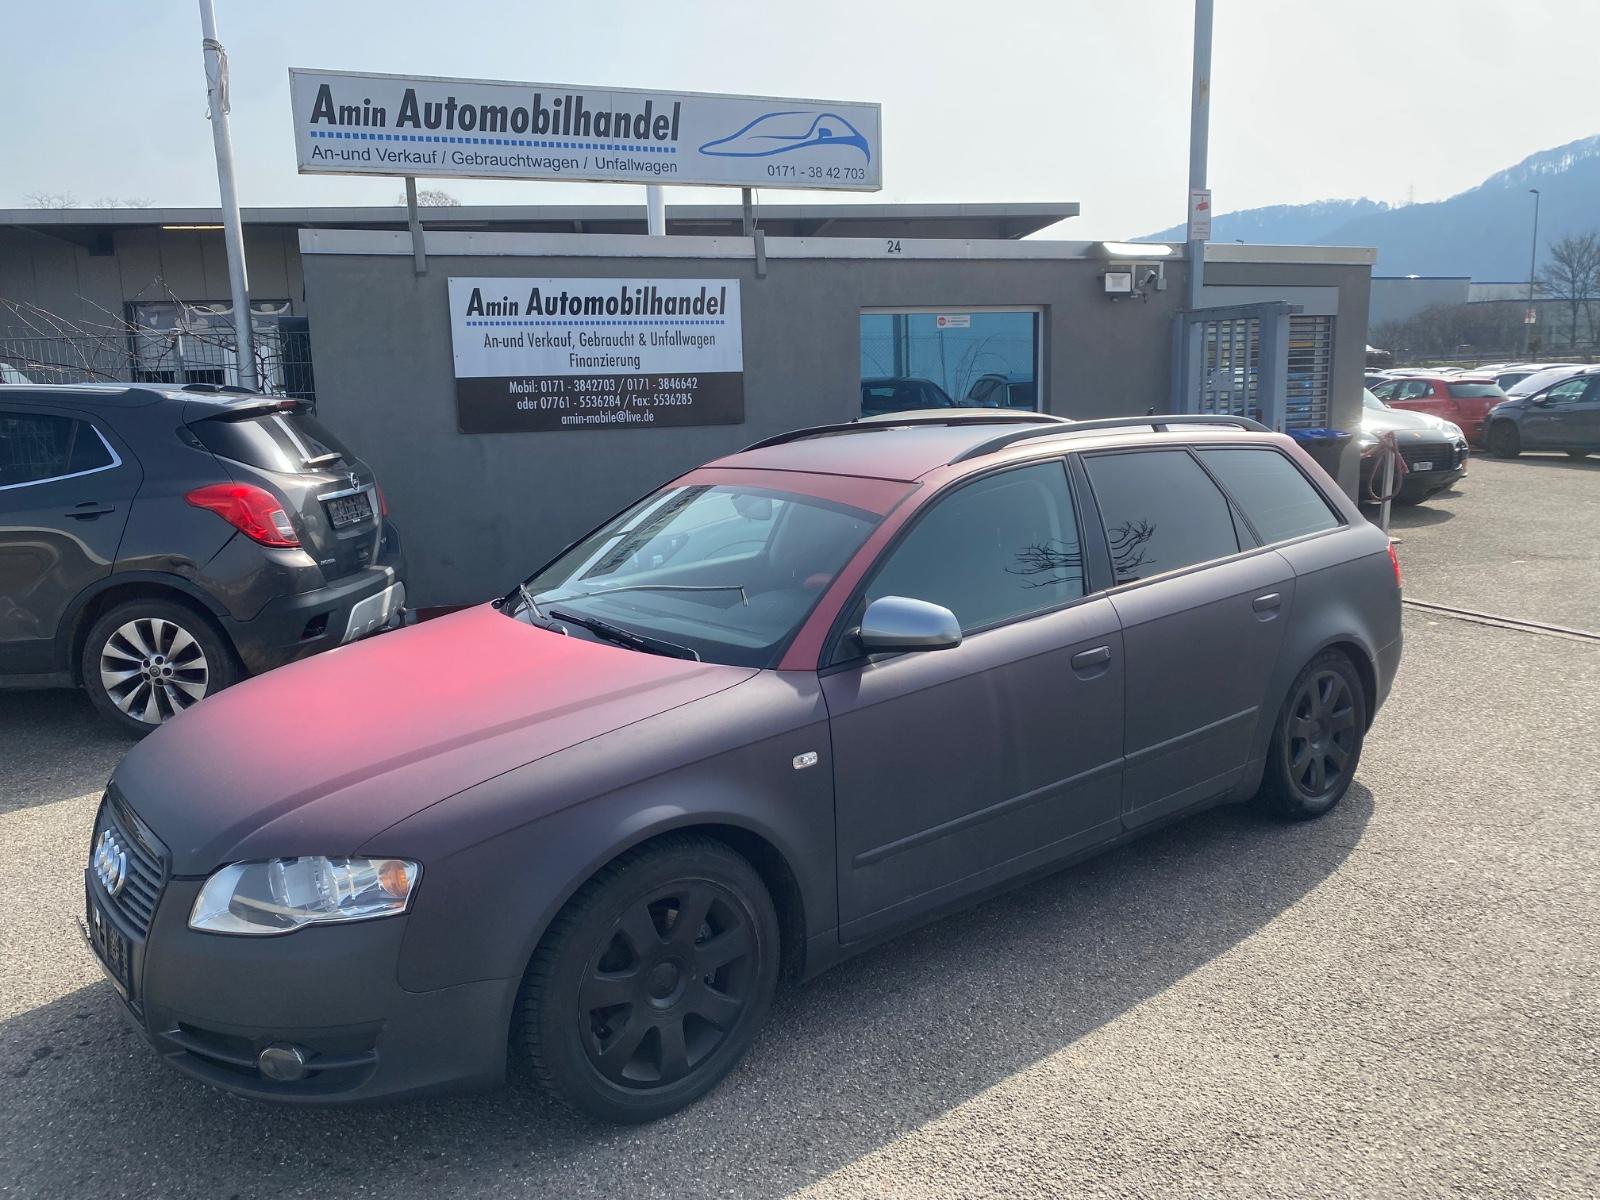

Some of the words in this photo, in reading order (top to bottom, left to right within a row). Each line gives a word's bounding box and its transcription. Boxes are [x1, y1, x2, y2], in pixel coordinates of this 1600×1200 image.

[310, 84, 386, 127] Amin
[396, 88, 681, 141] Automobilhandel
[312, 145, 371, 161] An-und
[376, 147, 437, 164] Verkauf
[451, 151, 579, 171] Gebrauchtwagen
[595, 157, 678, 175] Unfallwagen
[767, 164, 796, 177] 0171
[808, 166, 823, 178] 38
[826, 167, 841, 179] 42
[844, 167, 865, 180] 703
[887, 240, 901, 253] 24
[466, 287, 519, 316] Amin
[525, 286, 726, 316] Automobilhandel
[484, 331, 524, 348] An-und
[527, 330, 575, 350] Verkauf,
[579, 331, 634, 347] Gebraucht
[638, 332, 647, 346] &
[650, 330, 716, 349] Unfallwagen
[569, 352, 640, 370] Finanzierung
[509, 379, 538, 394] Mobil:
[540, 380, 564, 392] 0171
[574, 379, 615, 392] 3842703
[627, 378, 649, 390] 0171
[658, 377, 698, 390] 3846642
[517, 397, 537, 410] oder
[540, 396, 570, 409] 07761
[579, 395, 621, 408] 5536284
[632, 394, 650, 406] Fax:
[653, 393, 693, 406] 5536285
[561, 409, 654, 424] amin-mobile@live.de
